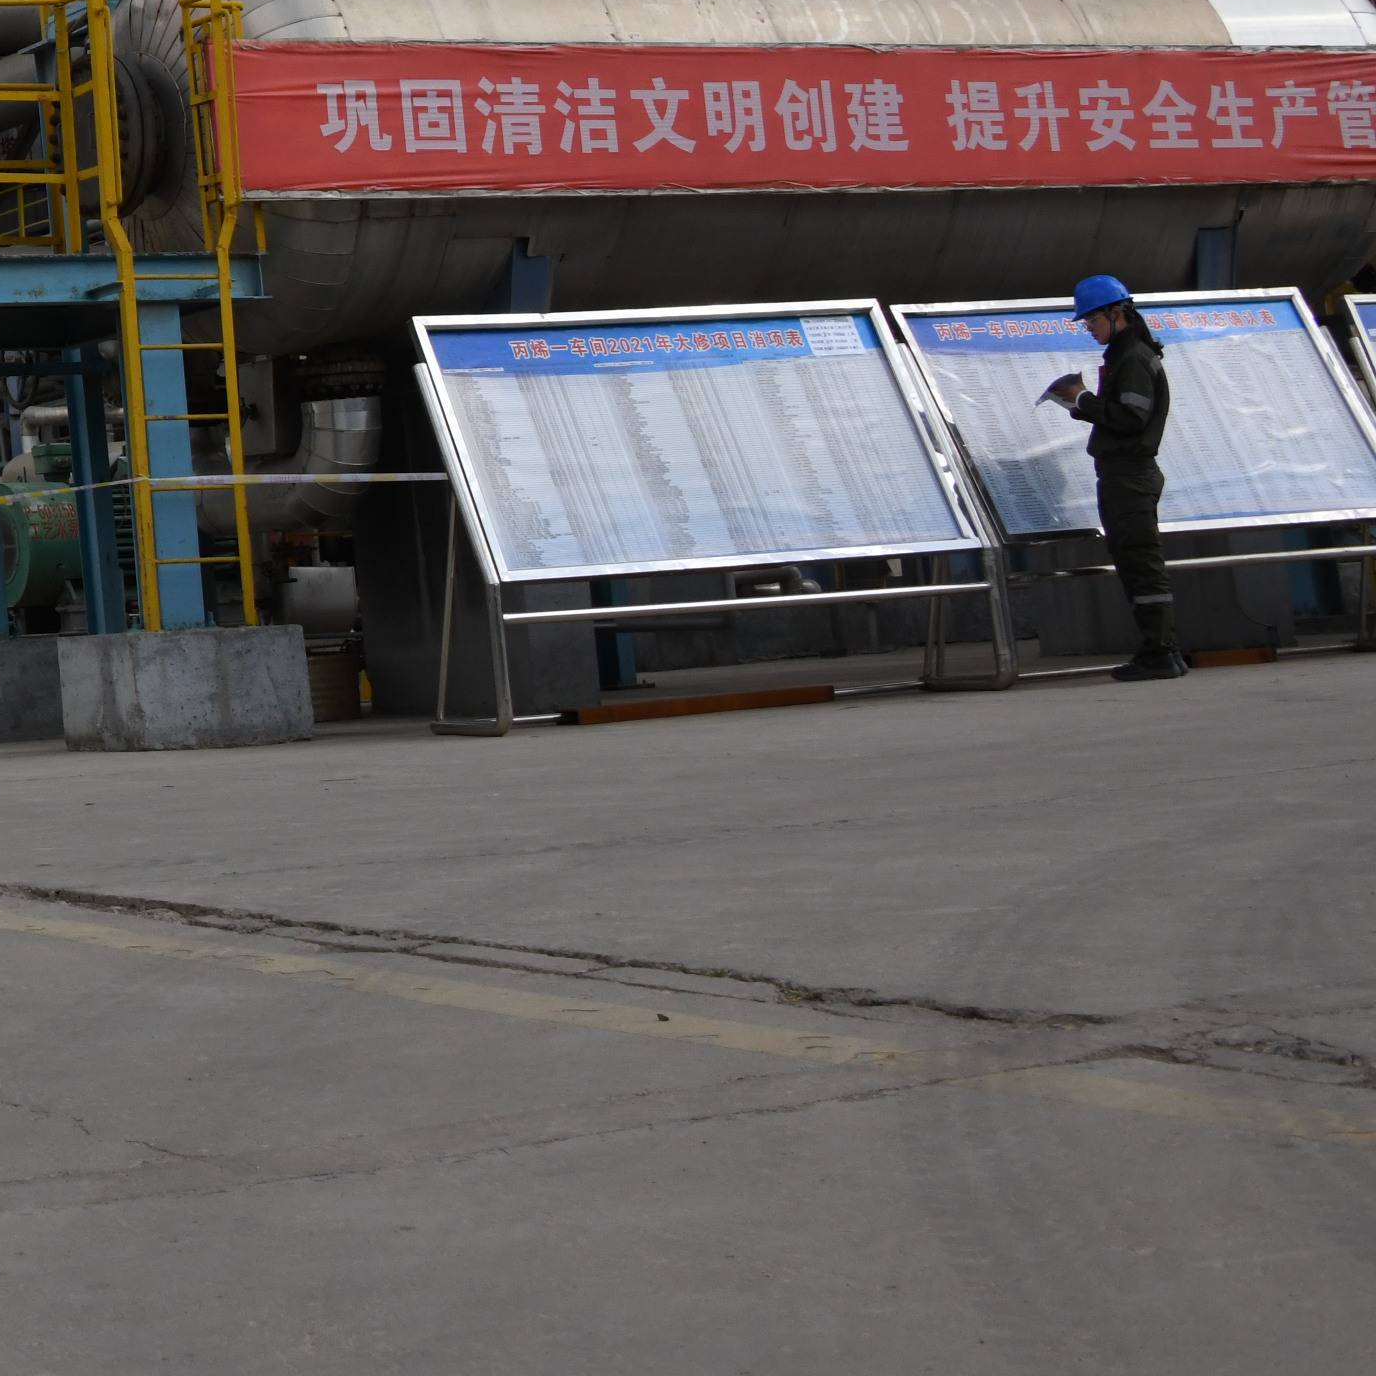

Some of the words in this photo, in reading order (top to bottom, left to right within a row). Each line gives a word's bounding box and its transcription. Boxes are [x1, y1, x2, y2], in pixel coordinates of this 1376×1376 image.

[316, 75, 911, 155] 巩固清洁文明创建
[945, 78, 1376, 153] 提升安全生产管
[509, 329, 805, 360] 丙烯一车间2021年大修项目消项表
